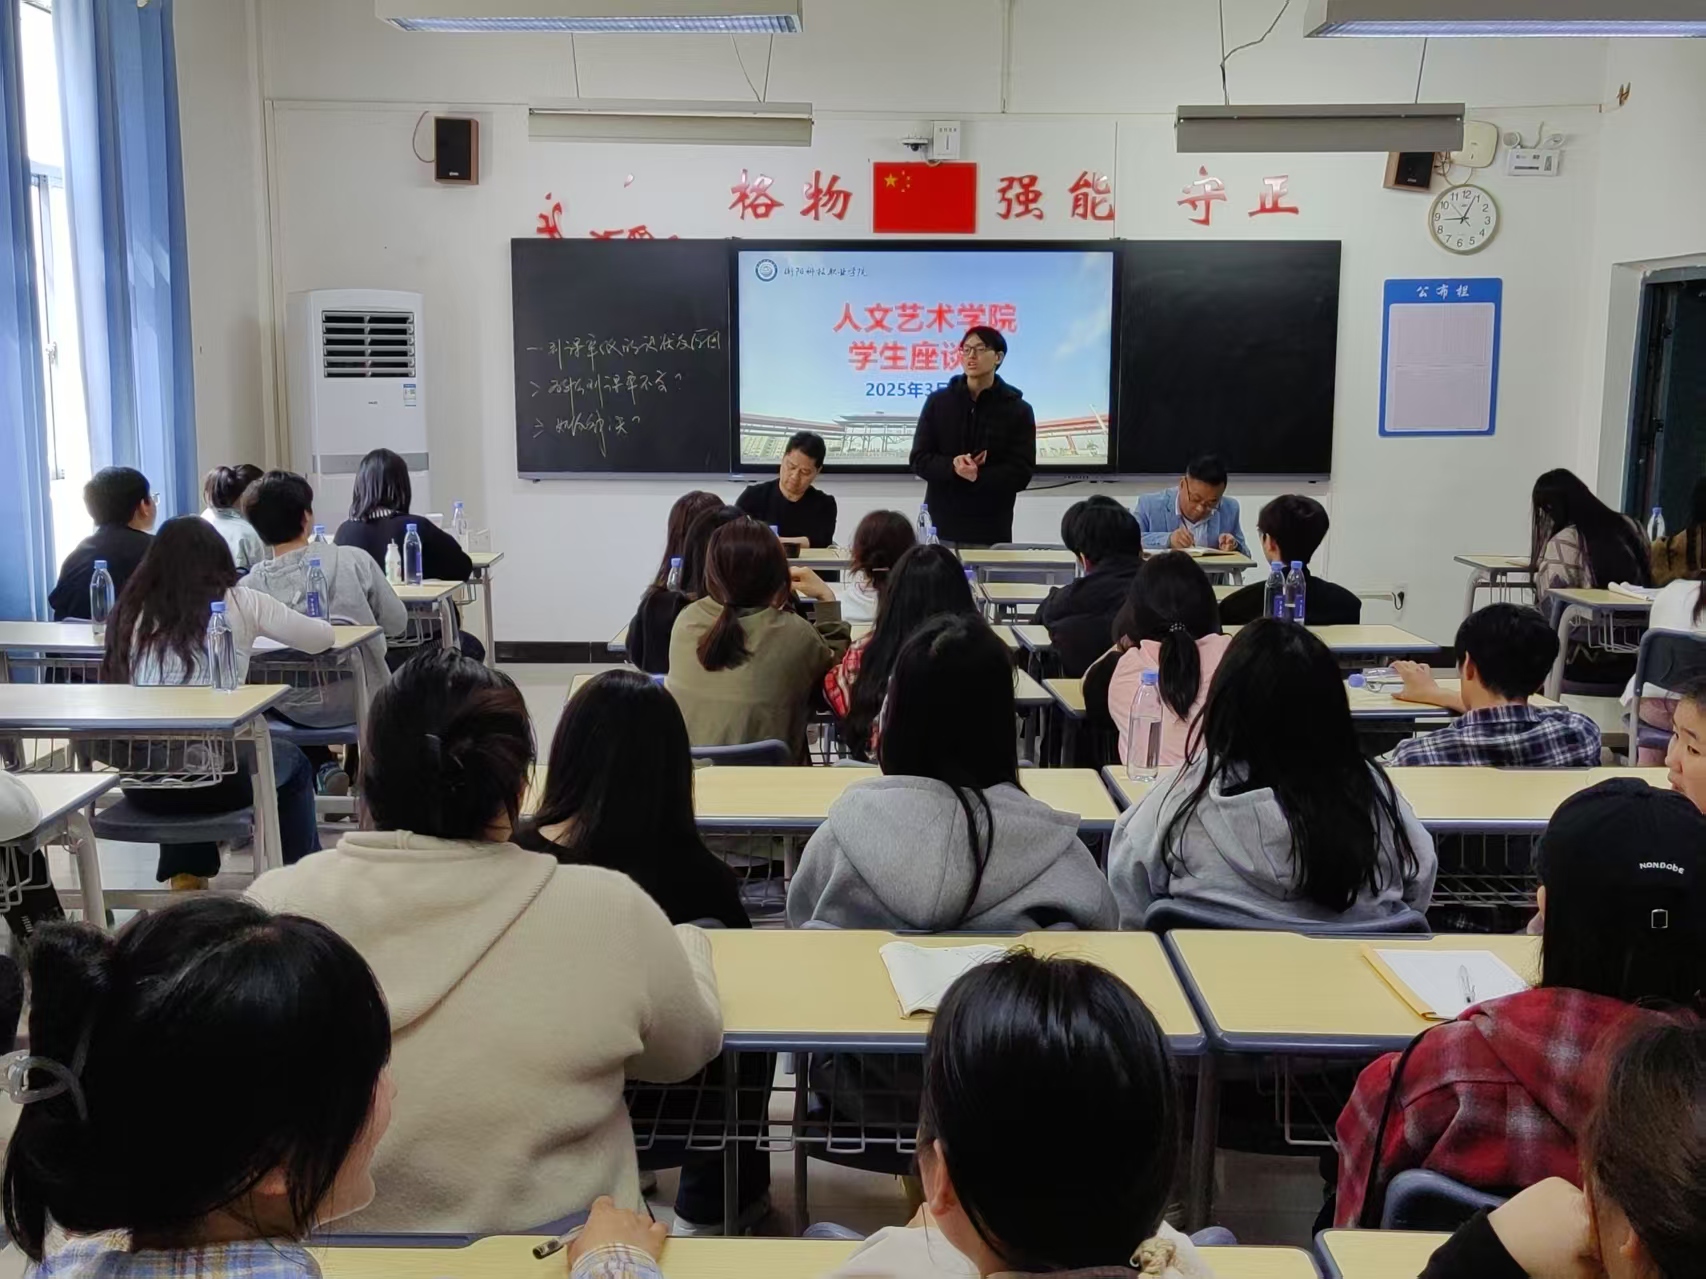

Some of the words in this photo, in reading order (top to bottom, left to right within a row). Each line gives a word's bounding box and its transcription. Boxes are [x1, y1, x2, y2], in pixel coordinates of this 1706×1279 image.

[728, 168, 854, 221] 格物
[995, 170, 1116, 221] 强能
[1176, 164, 1300, 226] 守正
[1450, 192, 1459, 201] 11
[1462, 190, 1472, 199] 12
[1441, 200, 1449, 210] 10
[1482, 203, 1489, 213] 2
[1434, 212, 1441, 222] 9
[1484, 216, 1491, 225] 3
[1437, 225, 1443, 235] 8
[1479, 228, 1485, 237] 4
[1445, 234, 1452, 243] 7
[1457, 238, 1463, 248] 6
[1469, 236, 1475, 245] 5
[832, 302, 1018, 334] 人文艺术学院
